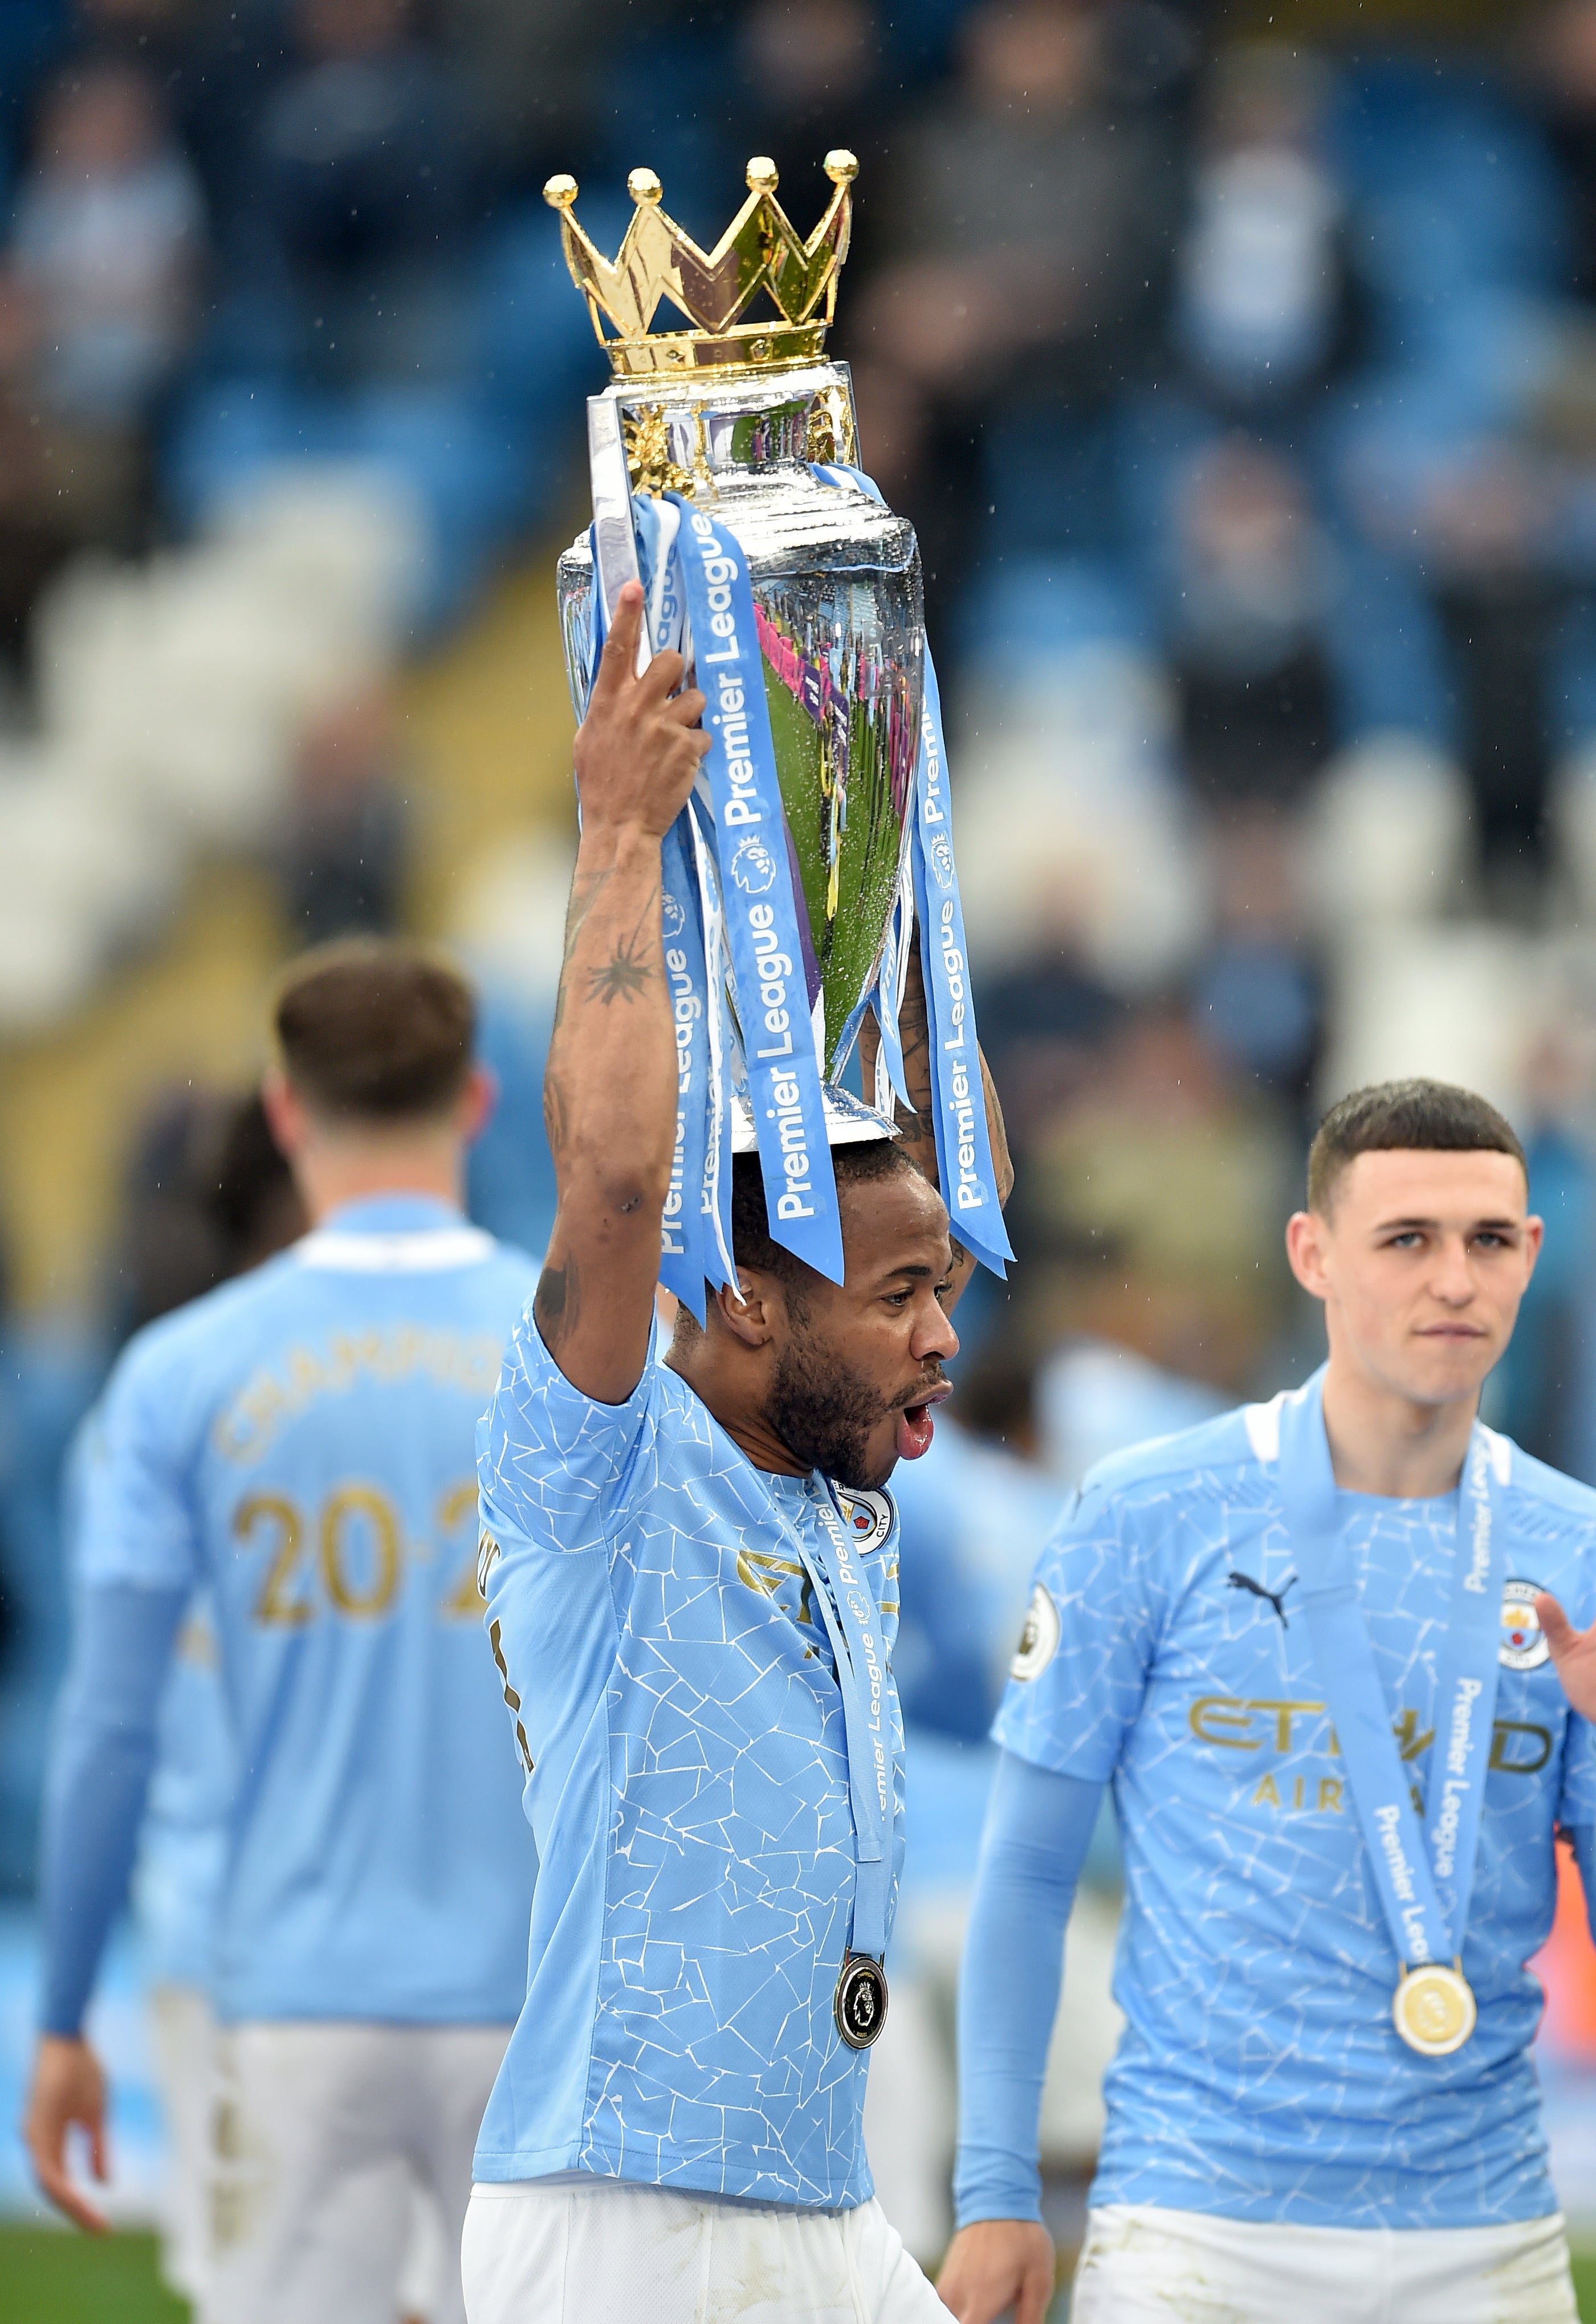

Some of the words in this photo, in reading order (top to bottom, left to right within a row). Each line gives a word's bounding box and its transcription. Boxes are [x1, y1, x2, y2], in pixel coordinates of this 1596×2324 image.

[691, 514, 739, 663] League
[712, 673, 762, 826] Premier
[749, 904, 793, 1058] League
[941, 900, 964, 1051] League
[766, 1067, 815, 1220] Premier
[948, 1060, 983, 1210] Premier
[812, 1502, 858, 1585] Premier
[876, 1514, 889, 1538] CITY
[1463, 1501, 1492, 1593] Premier
[862, 1632, 882, 1732] League
[1447, 1677, 1483, 1776] Premier
[873, 1737, 887, 1821] emier
[1431, 1779, 1471, 1878] League
[1374, 1804, 1415, 1902] Premier
[1401, 1905, 1434, 1963] Lea
